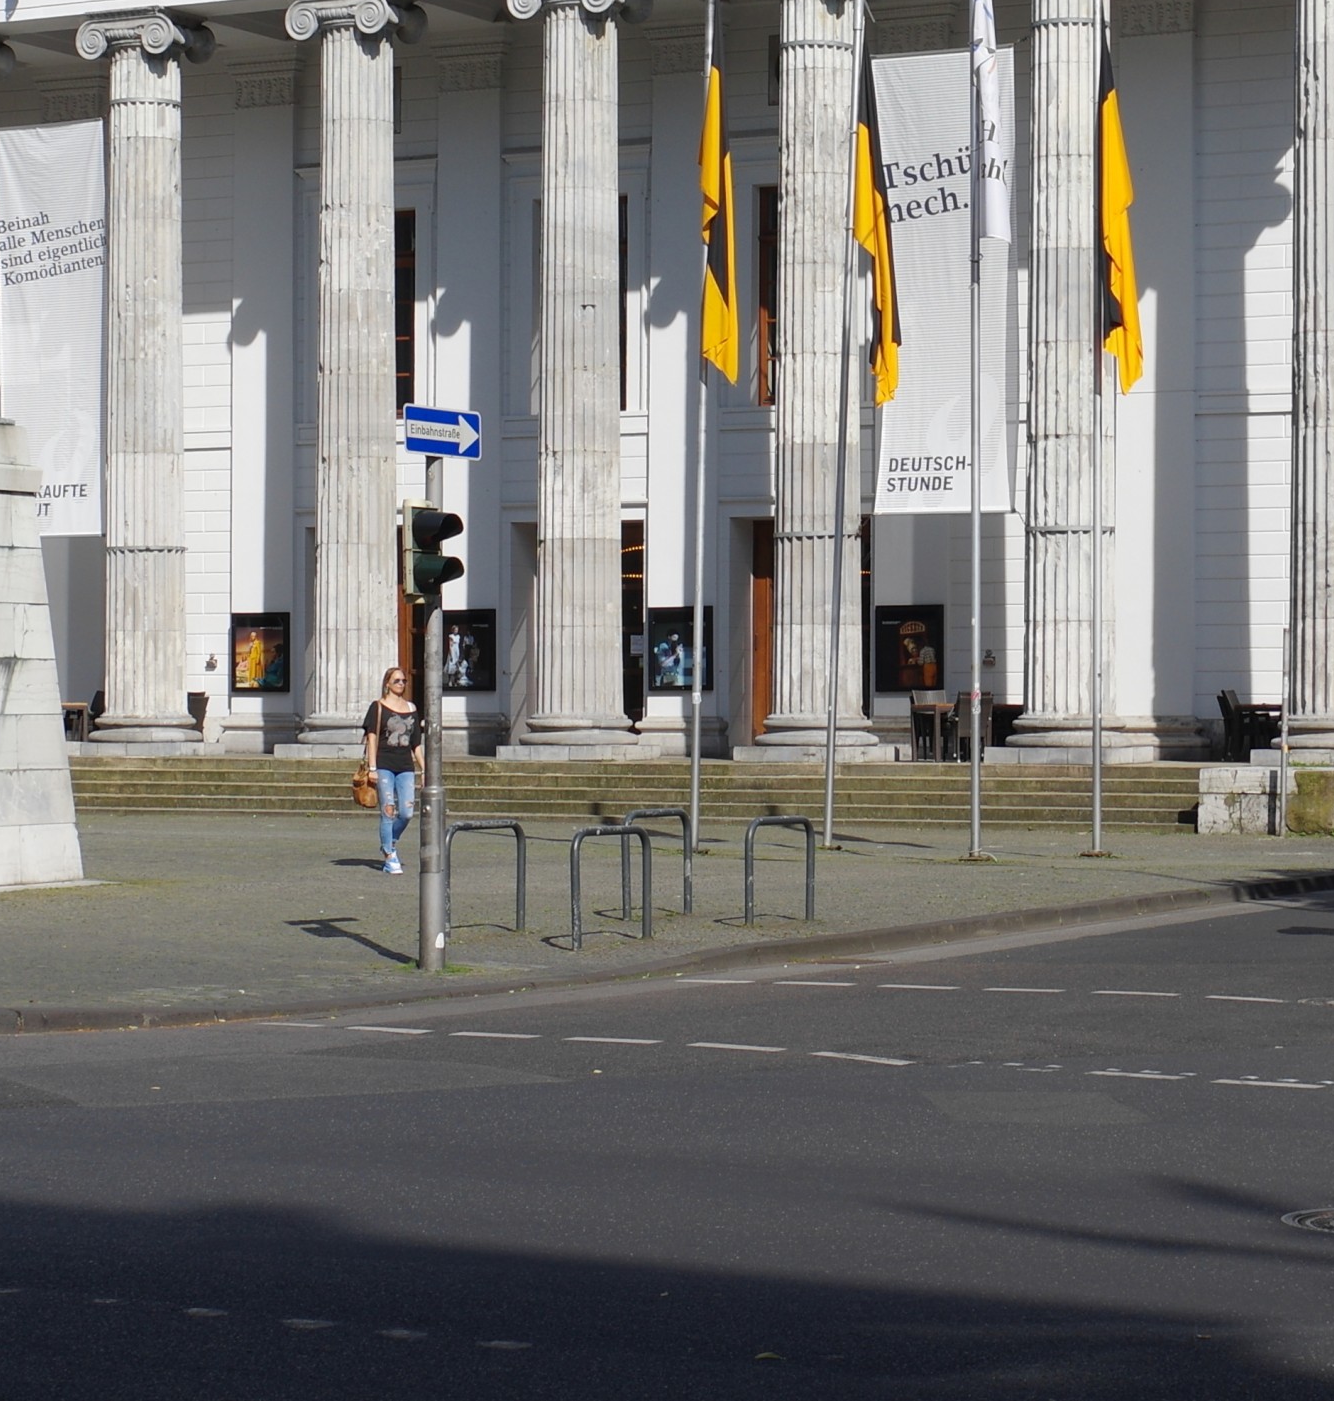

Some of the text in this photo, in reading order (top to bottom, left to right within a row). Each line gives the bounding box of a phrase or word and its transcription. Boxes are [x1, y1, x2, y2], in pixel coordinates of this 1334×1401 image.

[0, 218, 105, 252] alle Menschen
[1, 233, 107, 270] sind eigentlich
[410, 424, 460, 439] Einbahnstraße
[887, 476, 953, 492] STUNDE
